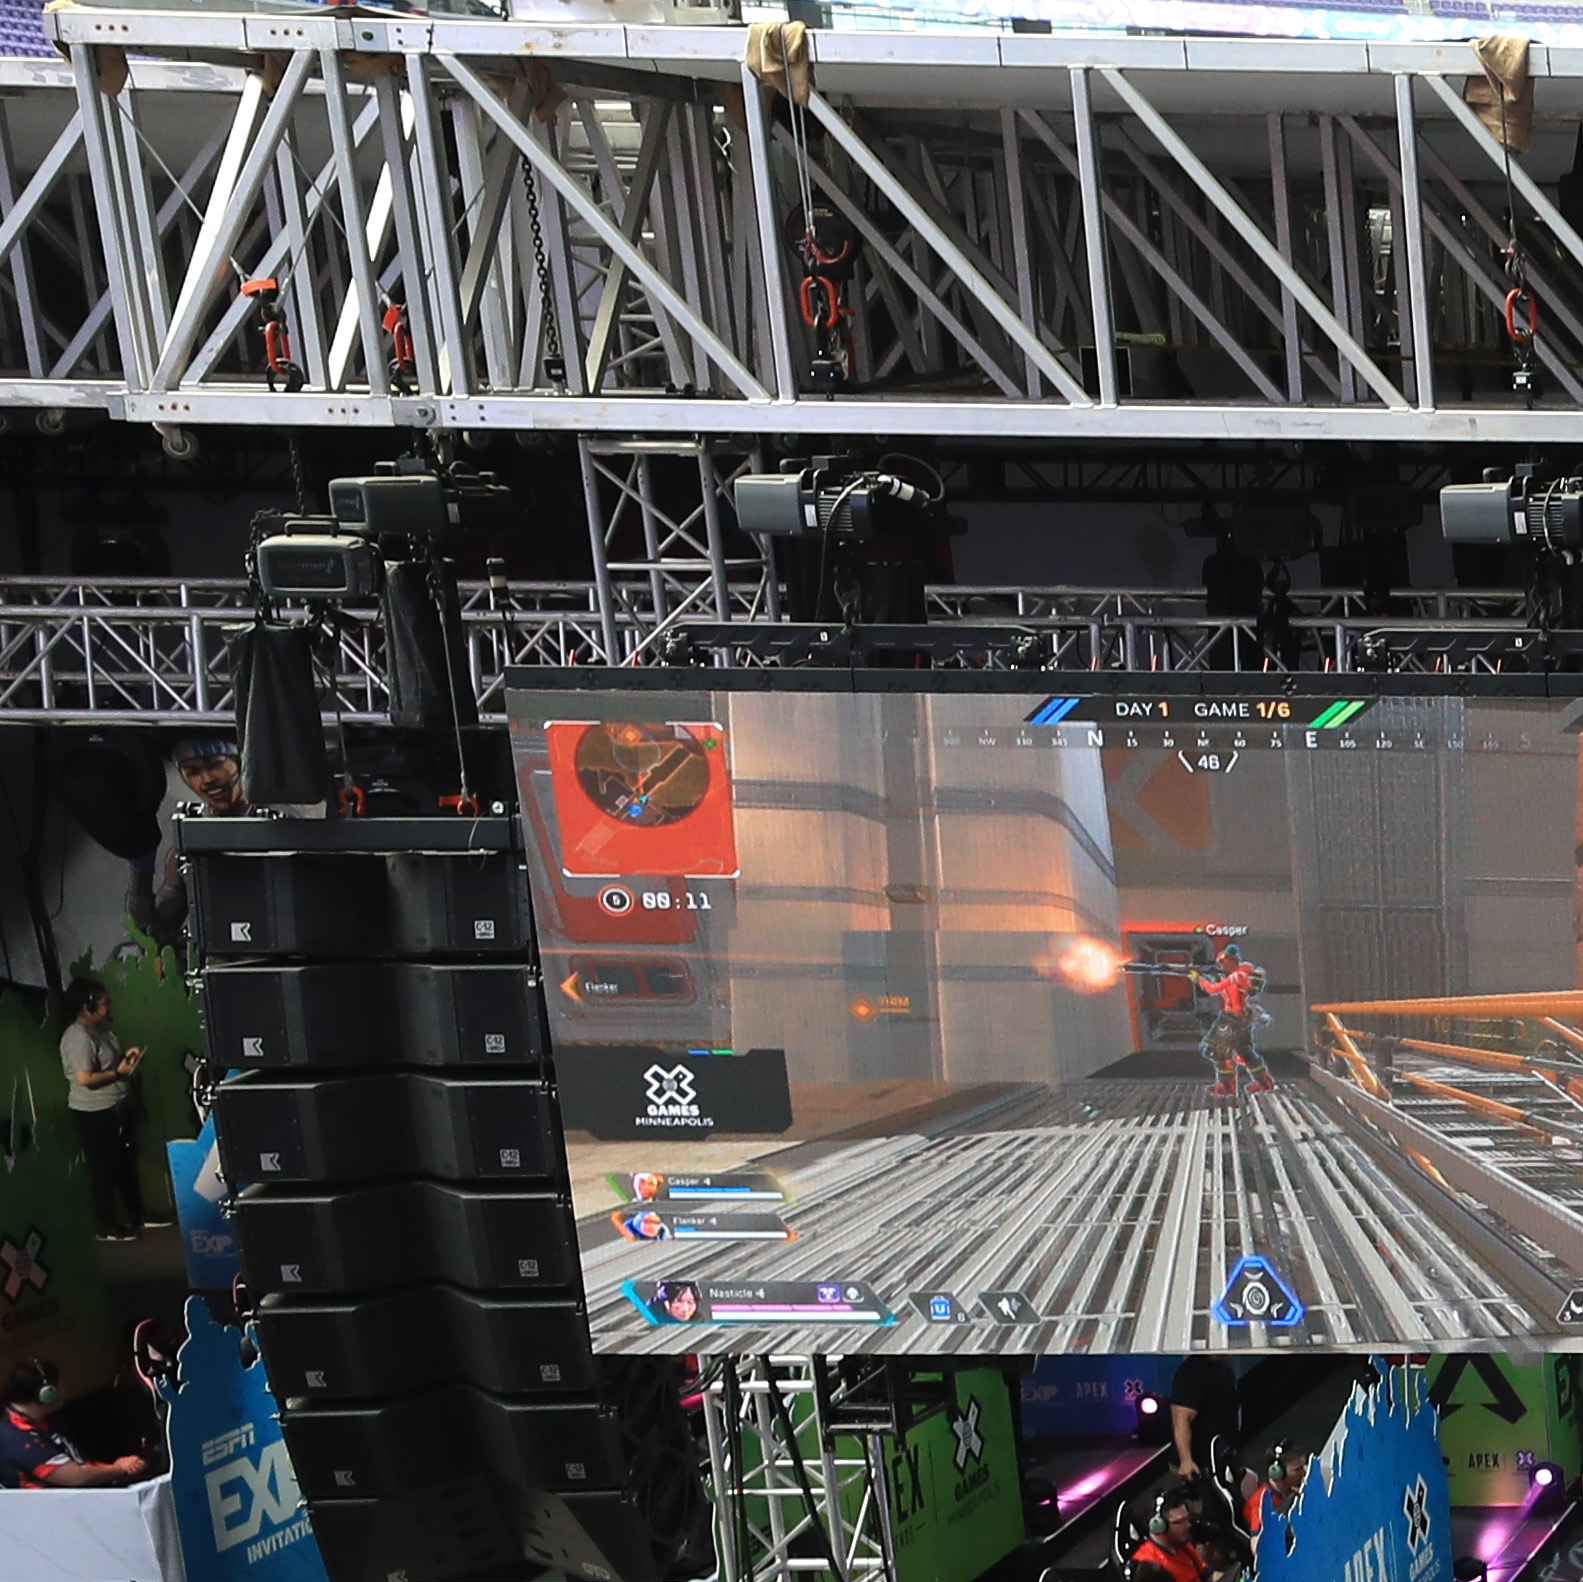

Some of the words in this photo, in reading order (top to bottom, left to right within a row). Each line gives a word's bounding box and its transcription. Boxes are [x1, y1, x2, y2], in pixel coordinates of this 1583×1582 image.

[1116, 702, 1153, 716] DAY
[1158, 702, 1168, 716] 1
[1194, 702, 1250, 717] GAME
[1257, 701, 1290, 718] 1/6
[1087, 730, 1103, 747] N
[1305, 732, 1317, 748] E
[1206, 923, 1249, 938] Casper
[647, 1104, 700, 1116] GAMES
[635, 1116, 714, 1127] MINNEAPOLIS
[202, 1423, 255, 1466] ESPN
[1468, 1454, 1500, 1469] APEX
[891, 1445, 925, 1526] EX
[1408, 1542, 1434, 1582] GAMES
